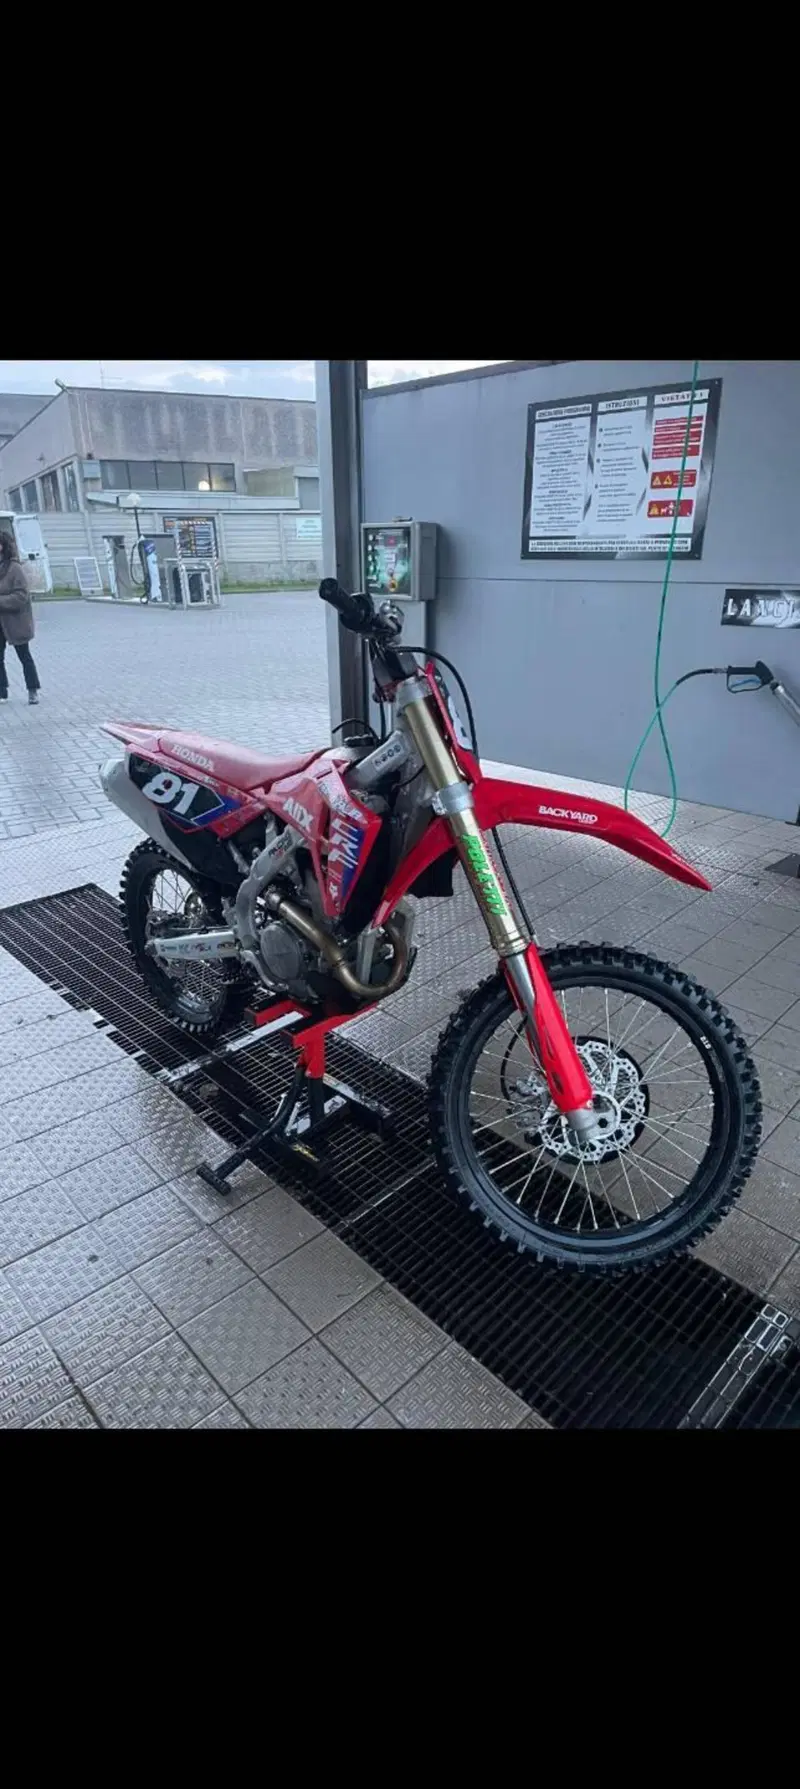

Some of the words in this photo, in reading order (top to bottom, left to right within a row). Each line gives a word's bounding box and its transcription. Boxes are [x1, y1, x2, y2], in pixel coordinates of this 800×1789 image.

[171, 744, 215, 772] HONDA
[142, 772, 200, 815] 81
[539, 805, 598, 823] BACKYARD
